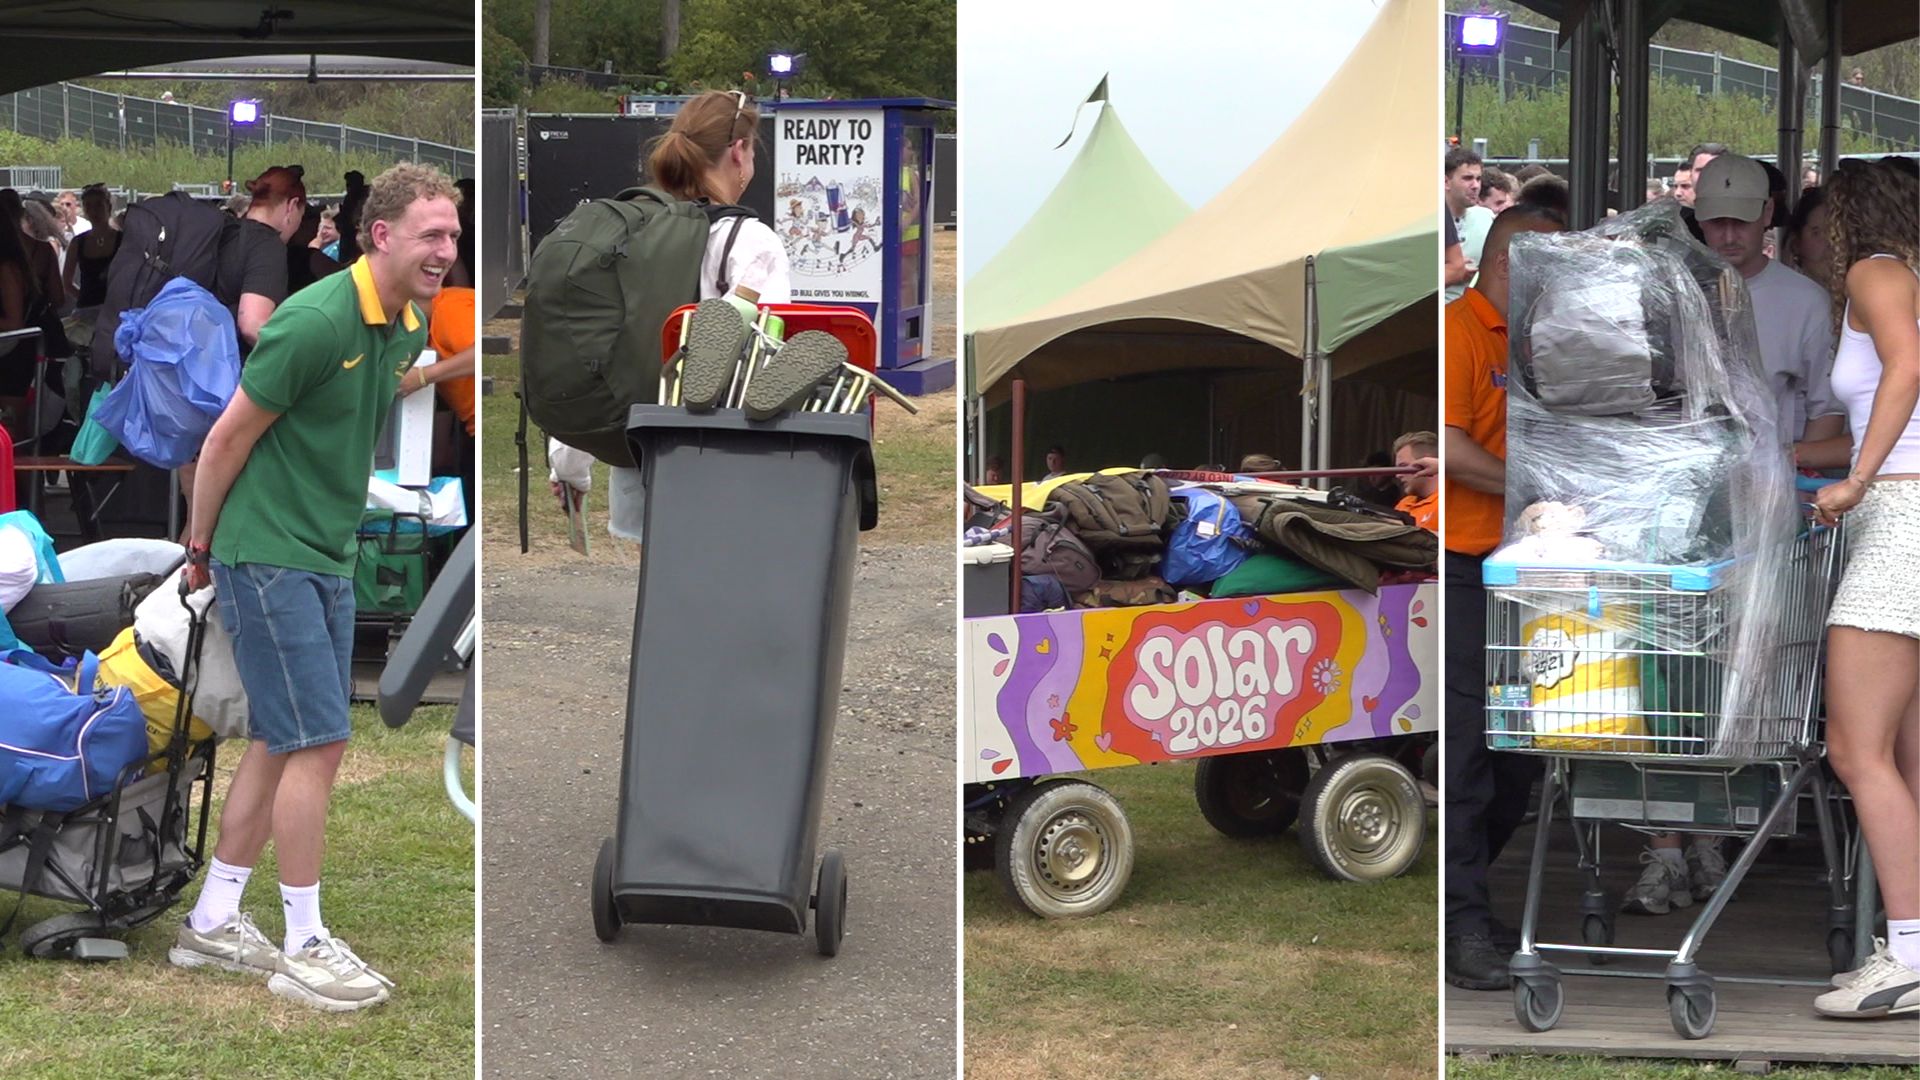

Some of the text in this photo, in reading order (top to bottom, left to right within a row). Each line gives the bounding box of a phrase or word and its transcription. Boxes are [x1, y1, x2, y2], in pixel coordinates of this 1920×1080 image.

[784, 118, 872, 140] READY TO
[797, 144, 864, 165] PARTY?
[790, 289, 799, 297] ED
[800, 289, 813, 297] BULL
[832, 290, 844, 298] YOU
[1169, 695, 1267, 752] 2026
